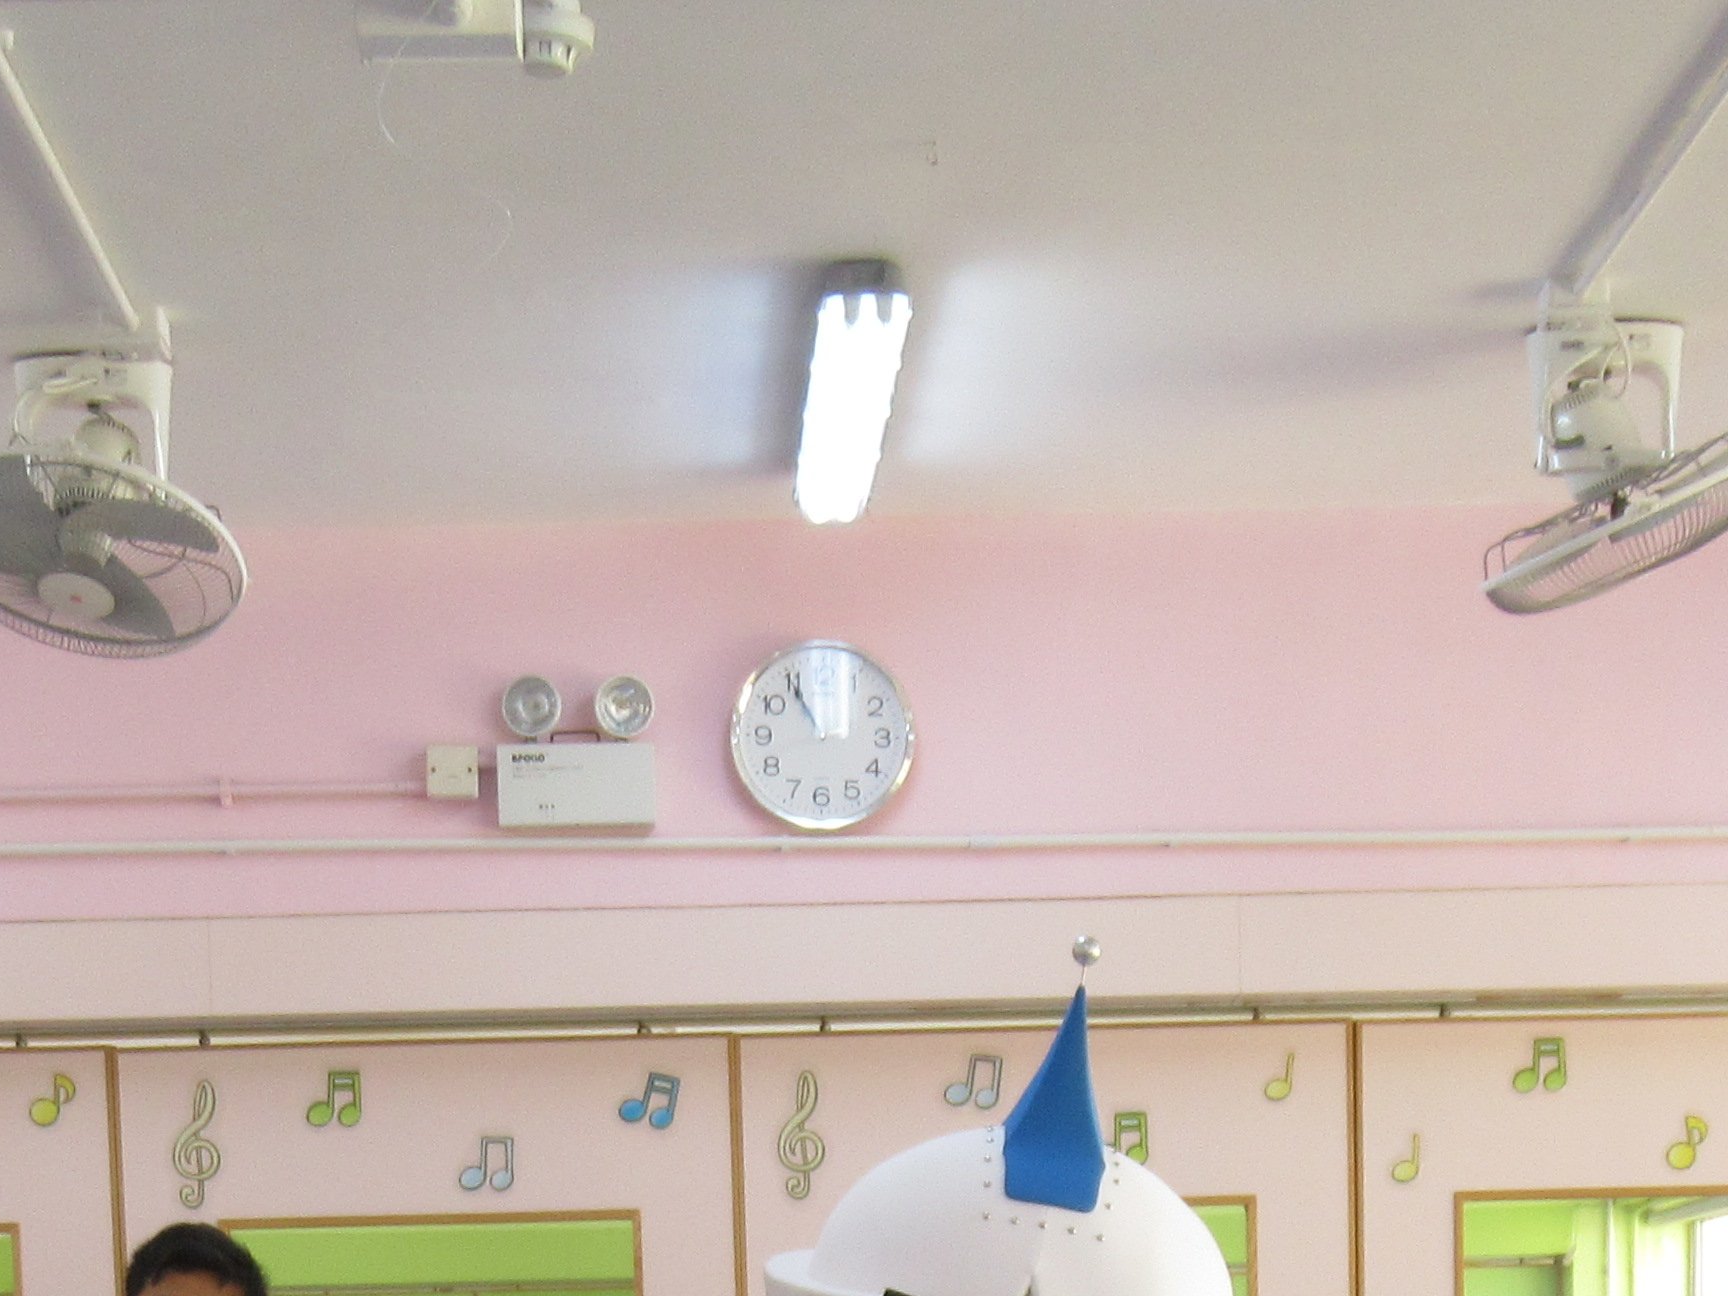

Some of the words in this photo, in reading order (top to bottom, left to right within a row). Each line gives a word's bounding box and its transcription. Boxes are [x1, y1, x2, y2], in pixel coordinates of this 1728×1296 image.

[763, 695, 785, 715] 10
[867, 696, 884, 717] 2
[755, 725, 772, 746] 9
[874, 728, 891, 749] 3
[763, 756, 780, 777] 8
[865, 757, 881, 777] 4
[786, 779, 802, 800] 7
[813, 786, 830, 807] 6
[844, 780, 860, 800] 5
